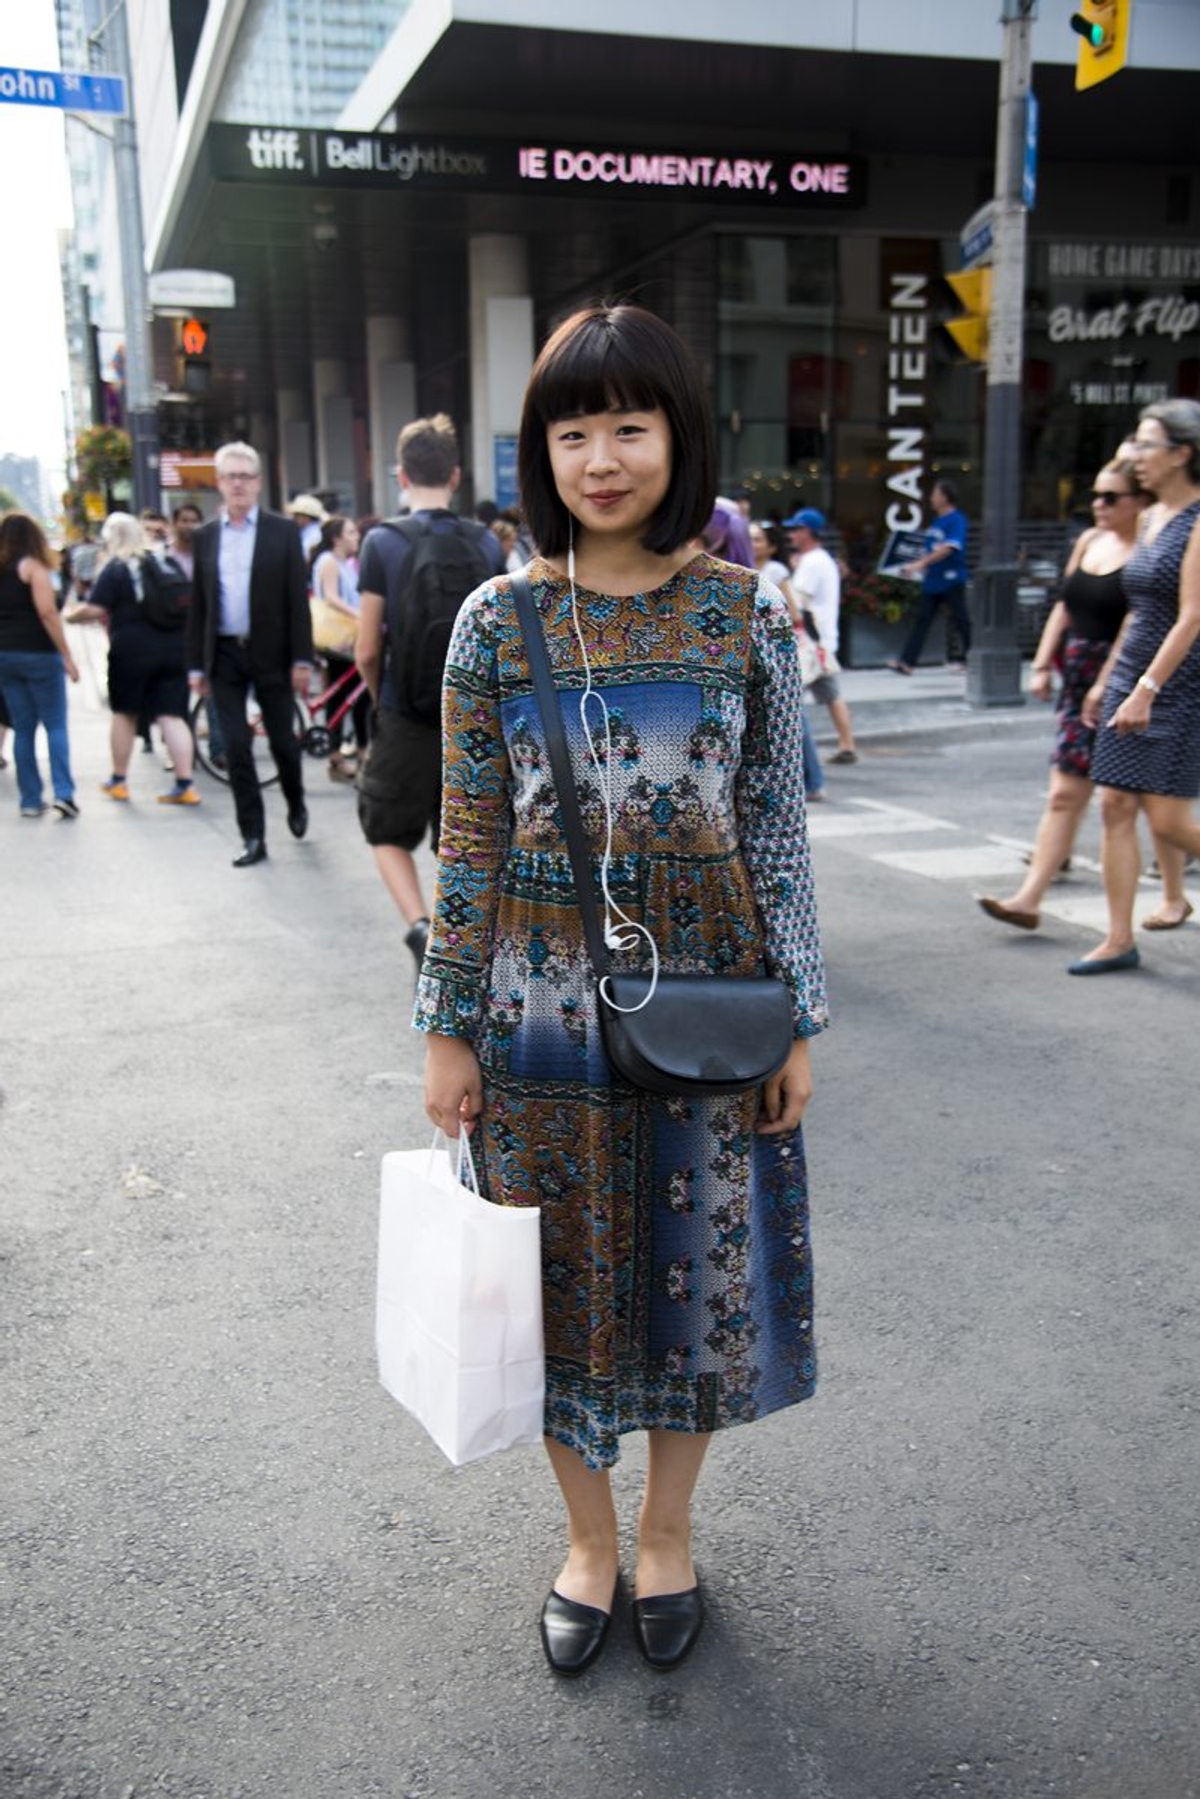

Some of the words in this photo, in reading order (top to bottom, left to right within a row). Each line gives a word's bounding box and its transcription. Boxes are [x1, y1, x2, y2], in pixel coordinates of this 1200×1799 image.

[0, 70, 55, 101] ohn
[553, 150, 777, 194] DOCUMENTARY,
[790, 162, 849, 193] ONE
[1048, 304, 1129, 342] Brat
[1134, 296, 1200, 342] Flip
[885, 274, 927, 533] CANTEEN
